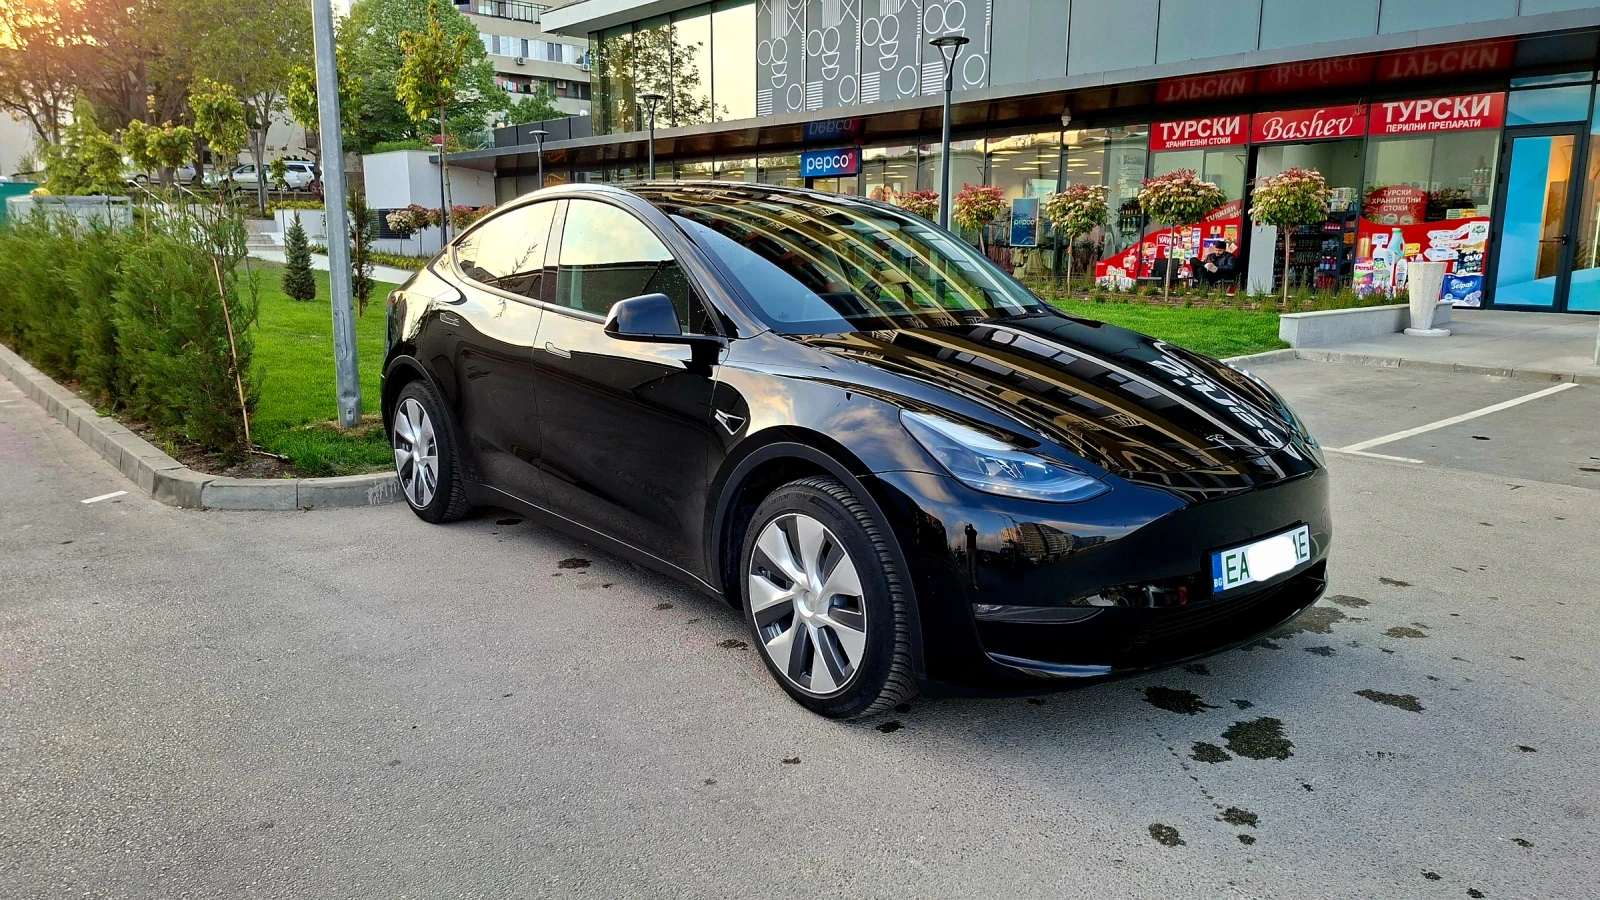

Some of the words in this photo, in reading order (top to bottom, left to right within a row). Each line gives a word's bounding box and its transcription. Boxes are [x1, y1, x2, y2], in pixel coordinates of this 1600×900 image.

[1382, 95, 1491, 123] ТУРСКИ
[1160, 116, 1240, 141] ТУРСКИ
[1262, 109, 1354, 141] Bashev
[1385, 122, 1427, 133] ПЕРИЛНИ
[1428, 118, 1482, 131] ПРЕПАРАТИ
[1165, 138, 1208, 149] ХРАНИТЕЛНИ
[1208, 136, 1231, 146] СТОКИ
[1383, 189, 1412, 197] ТУРСКИ
[1205, 205, 1237, 222] TURKISH
[1213, 577, 1223, 588] BG
